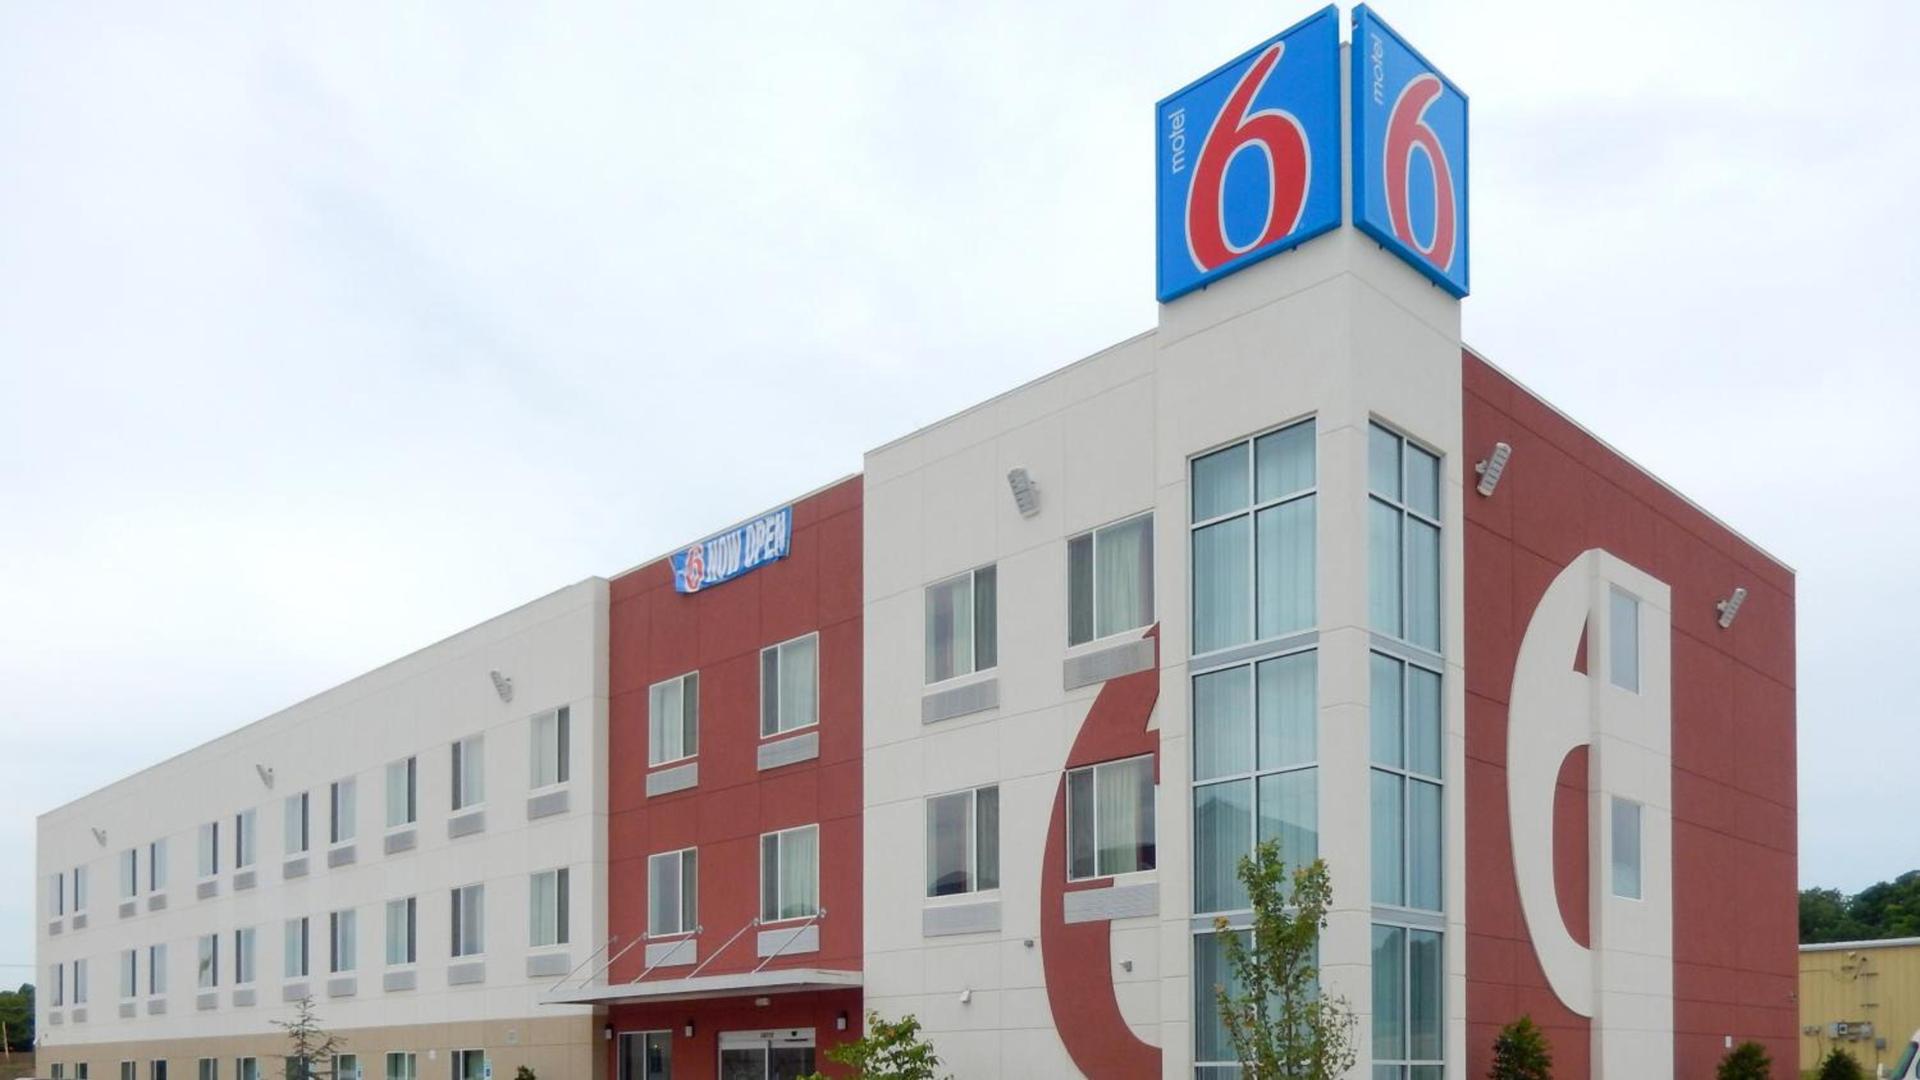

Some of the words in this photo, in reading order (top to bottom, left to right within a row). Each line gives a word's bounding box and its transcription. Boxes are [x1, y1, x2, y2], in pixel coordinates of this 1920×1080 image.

[1370, 33, 1384, 105] motel
[1168, 107, 1186, 175] motel
[1184, 40, 1312, 273] 6
[1383, 72, 1457, 273] 6
[704, 529, 742, 583] NOW
[744, 510, 786, 569] OPEN
